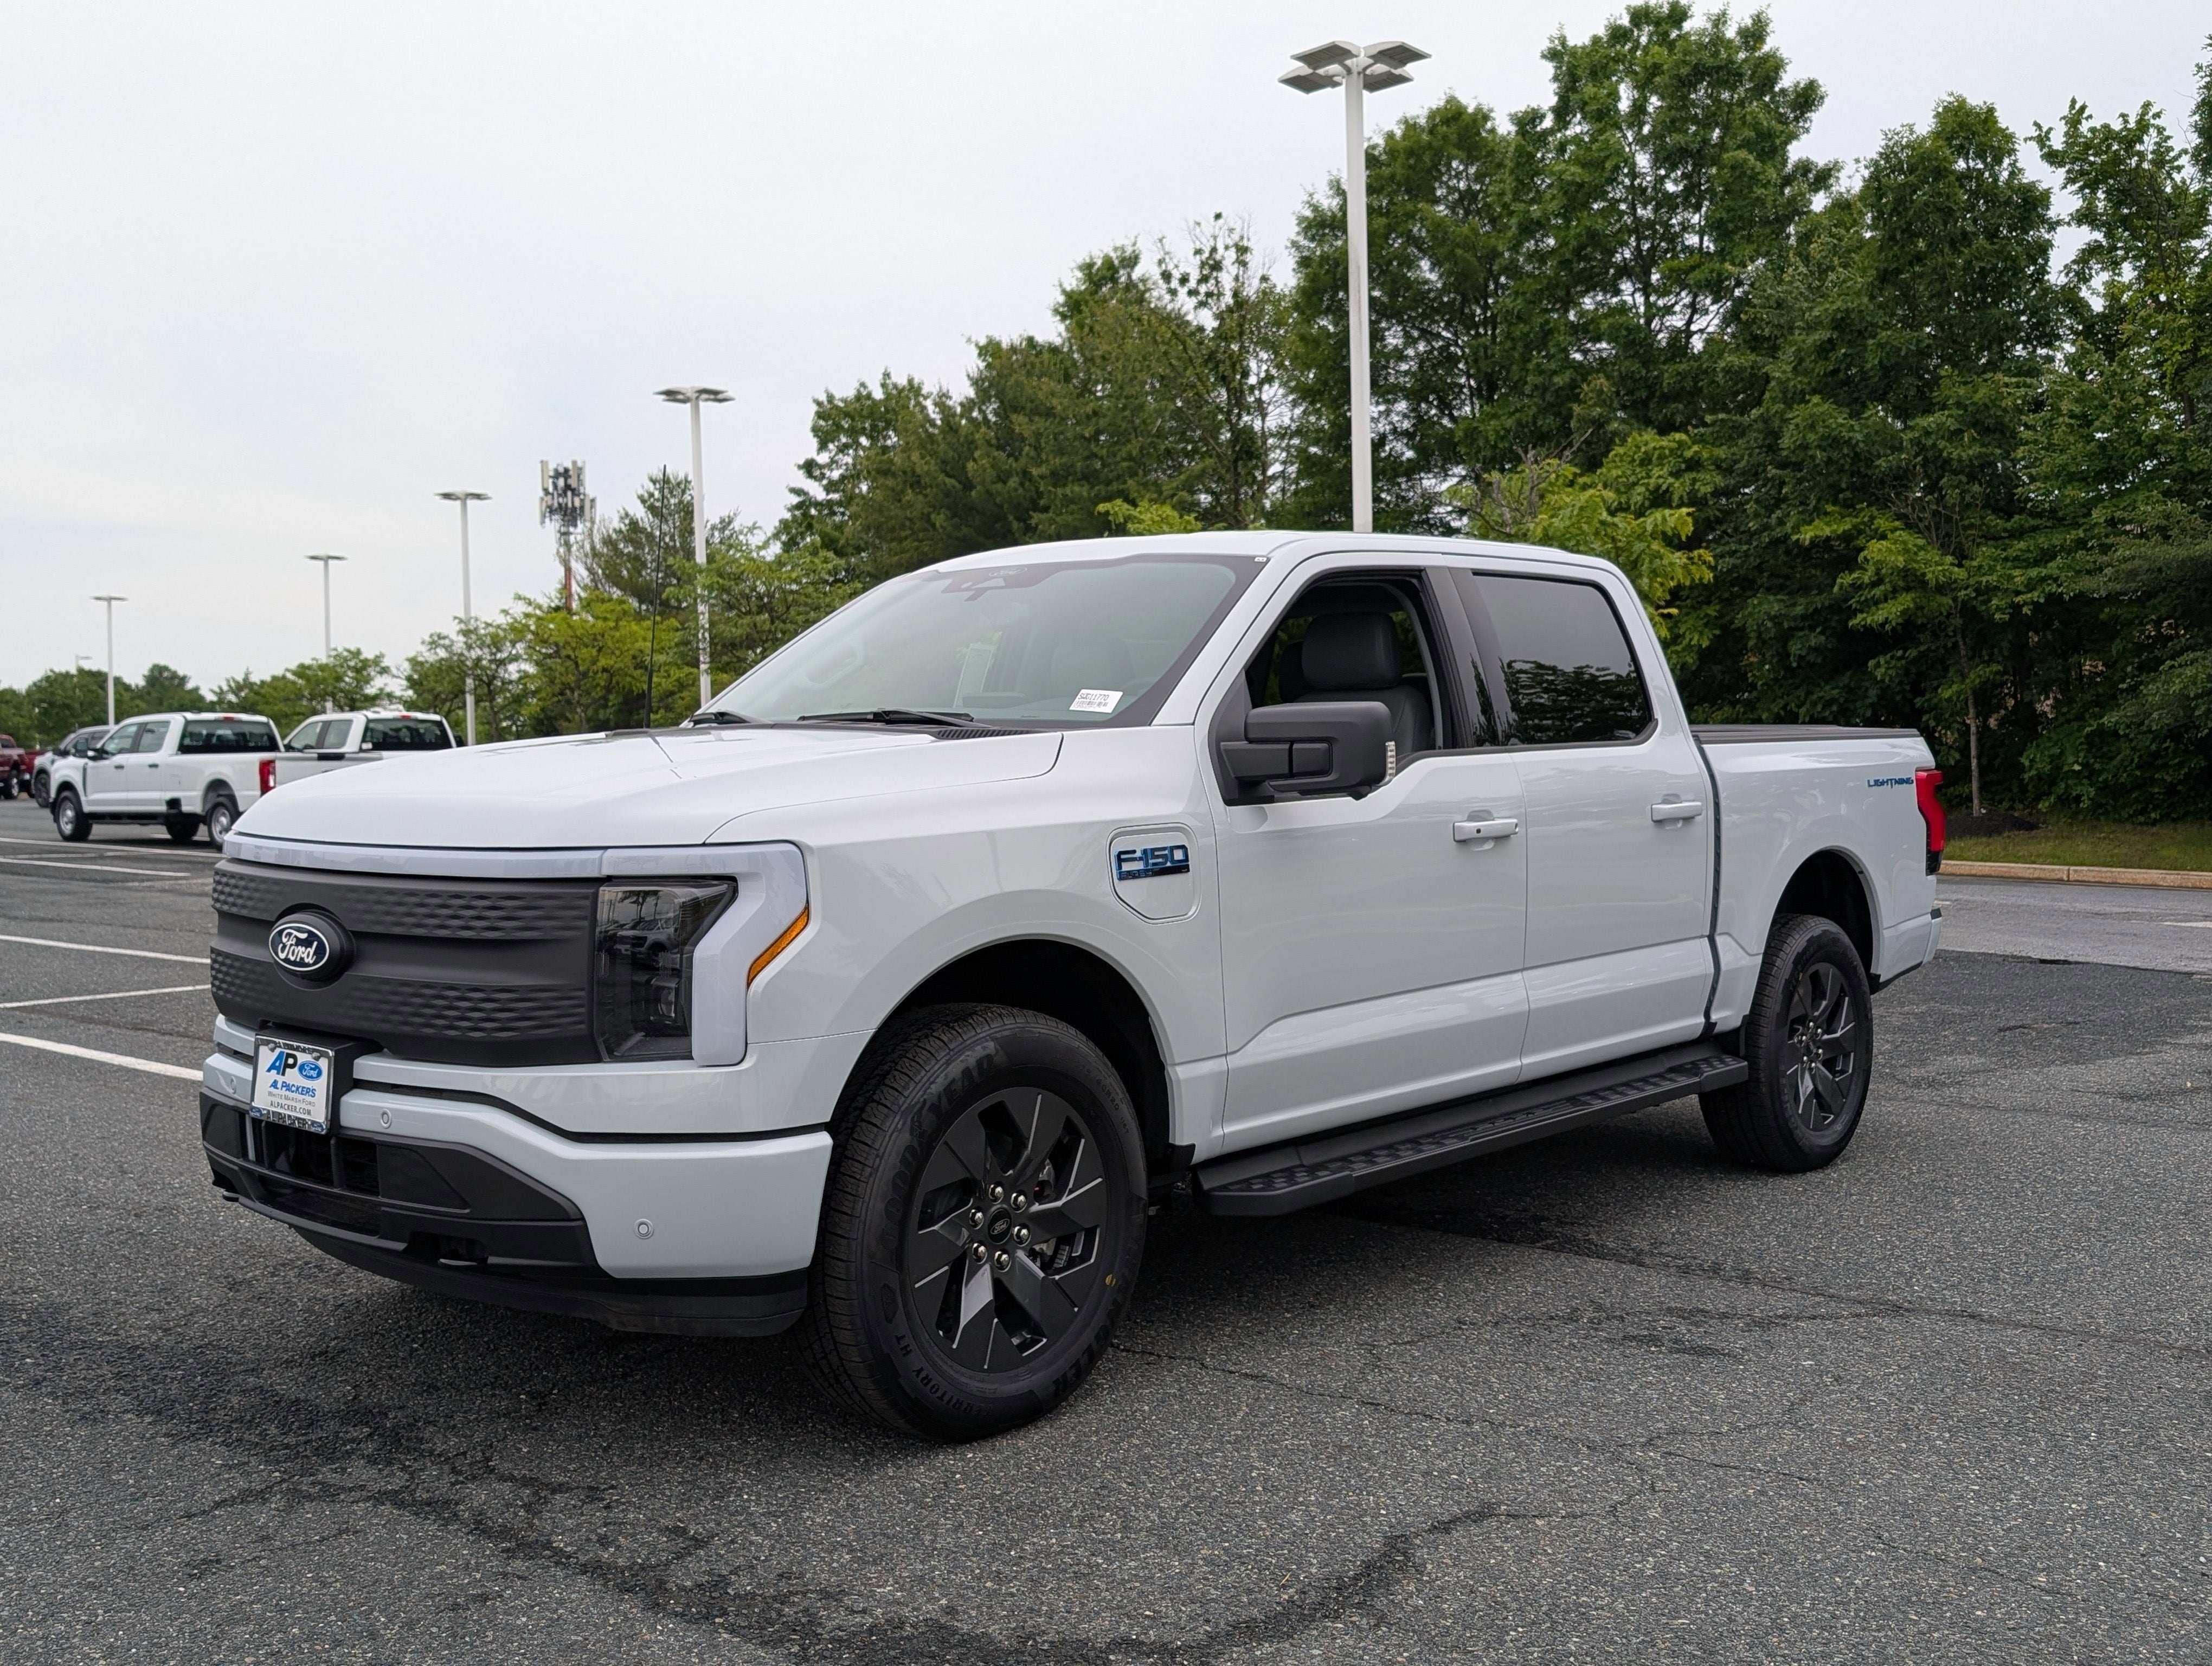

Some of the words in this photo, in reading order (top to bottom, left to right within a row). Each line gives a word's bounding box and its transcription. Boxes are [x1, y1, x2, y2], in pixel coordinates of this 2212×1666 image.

[1867, 777, 1914, 789] LIGHTNING
[1114, 844, 1189, 871] F-150
[278, 928, 318, 964] Ford
[266, 1050, 298, 1077] AP
[302, 1063, 319, 1078] Ford
[269, 1079, 280, 1090] AL
[280, 1080, 317, 1098] PACKER'S
[270, 1100, 312, 1117] ALPACKER.COM
[894, 1334, 913, 1357] HT
